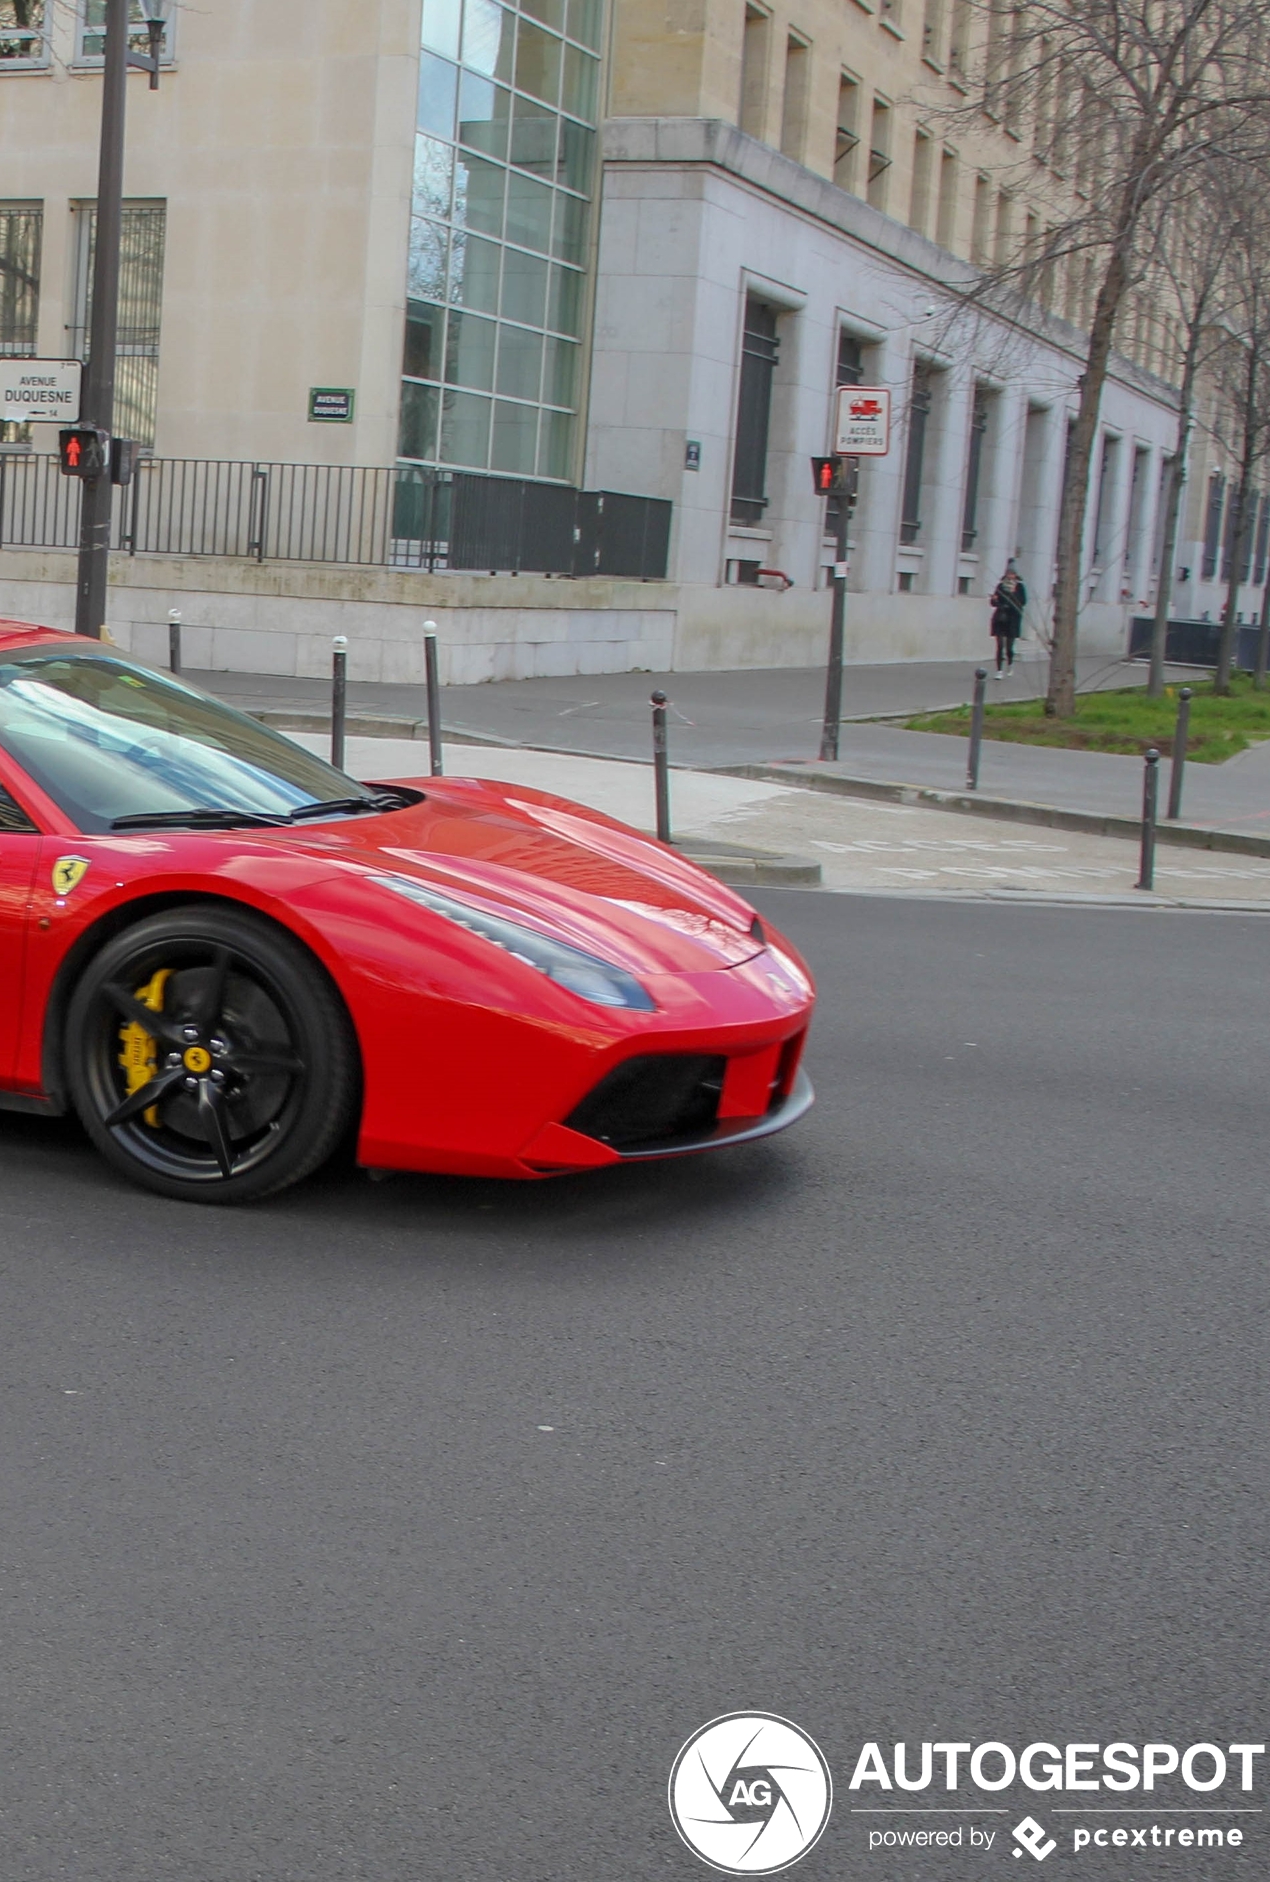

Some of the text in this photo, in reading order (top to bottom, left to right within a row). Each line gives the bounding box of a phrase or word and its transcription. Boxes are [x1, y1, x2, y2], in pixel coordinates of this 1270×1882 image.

[20, 376, 57, 387] AVENUE
[5, 390, 72, 403] DUQUESNE
[840, 437, 884, 446] POMPIERS
